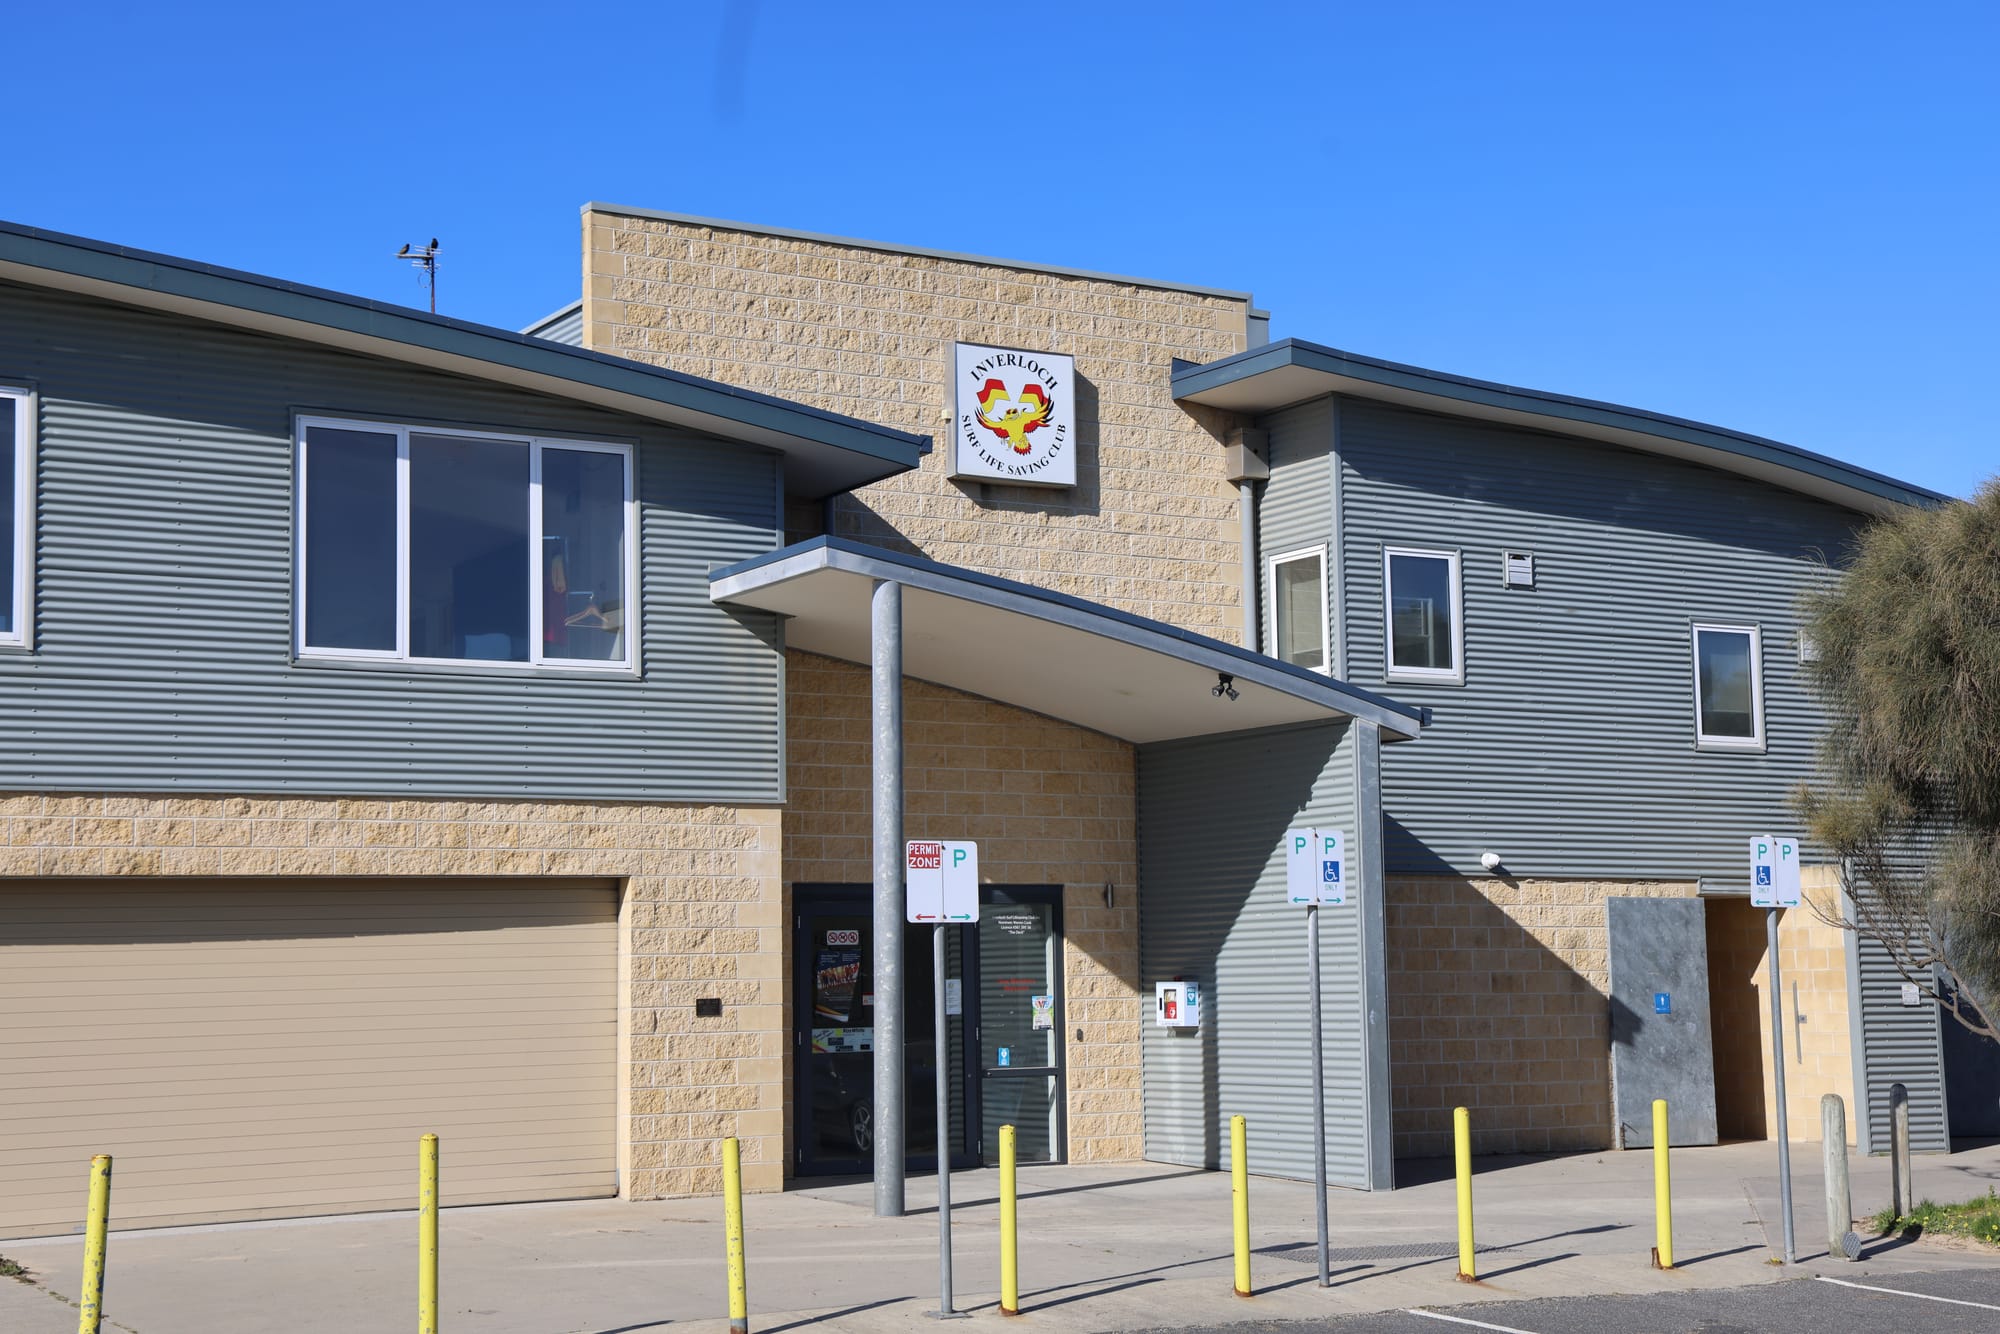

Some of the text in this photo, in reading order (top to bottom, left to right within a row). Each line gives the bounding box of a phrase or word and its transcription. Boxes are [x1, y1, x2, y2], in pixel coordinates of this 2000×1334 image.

[970, 353, 1059, 391] INVERLOCH
[961, 414, 1066, 476] SURF LIFE SAVING CLUB
[909, 844, 940, 855] PERMIT
[1295, 836, 1306, 855] P
[1325, 836, 1336, 855] P
[1758, 843, 1768, 860] P
[1782, 844, 1792, 861] P
[909, 857, 940, 868] ZONE
[953, 848, 967, 868] P
